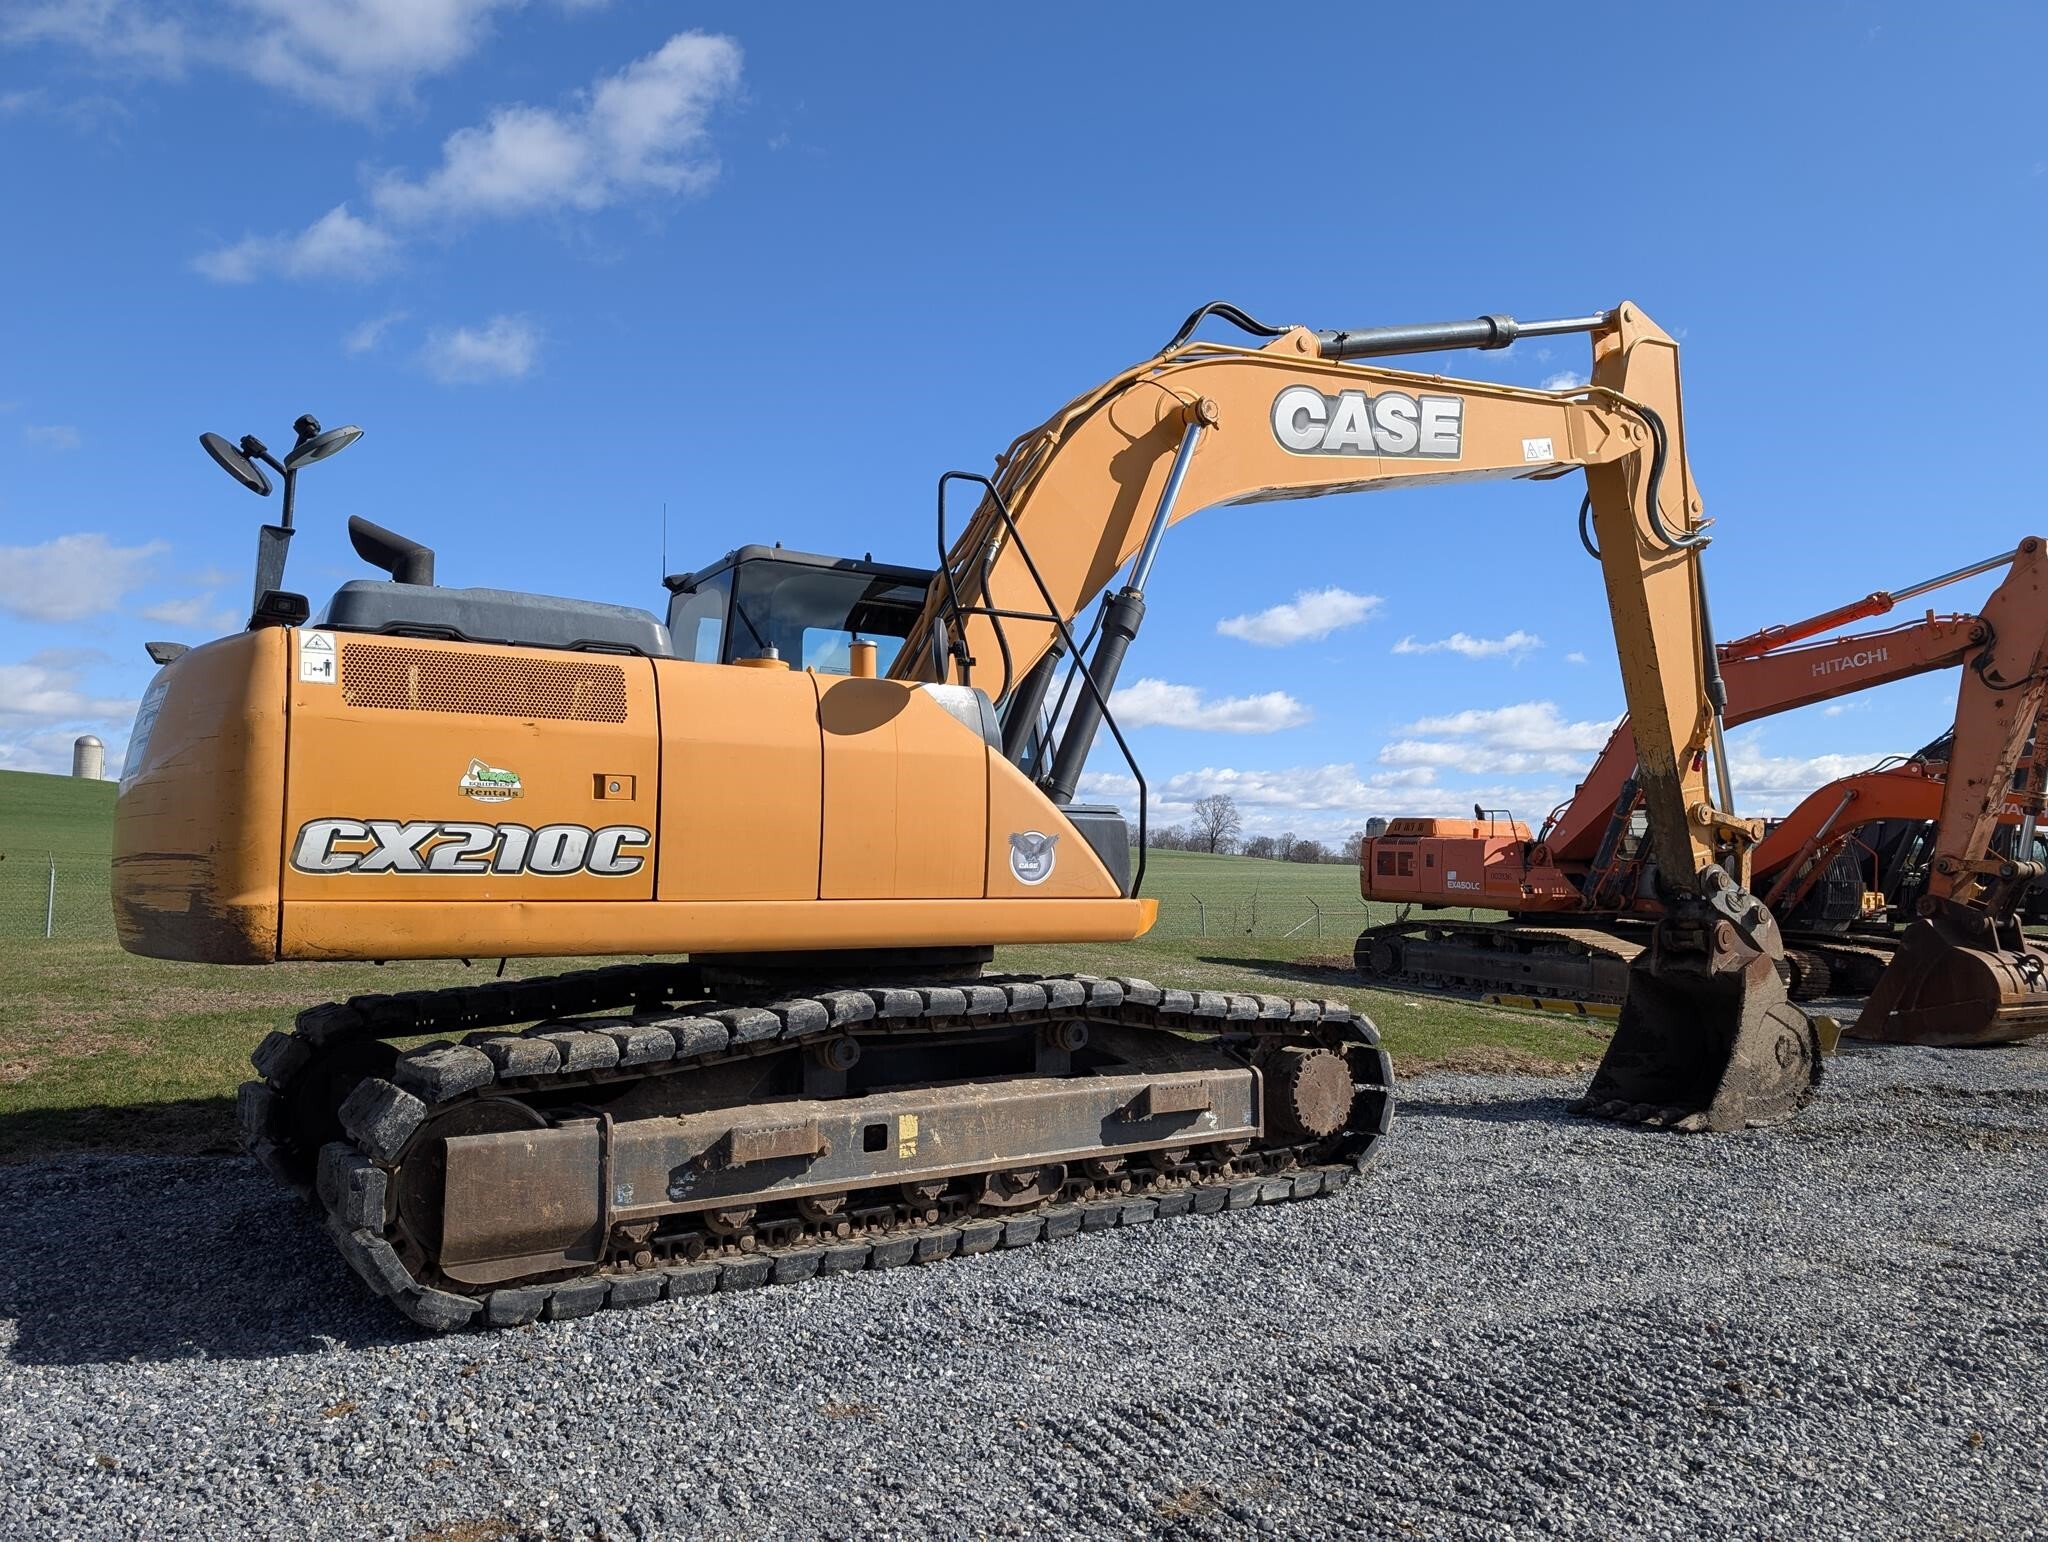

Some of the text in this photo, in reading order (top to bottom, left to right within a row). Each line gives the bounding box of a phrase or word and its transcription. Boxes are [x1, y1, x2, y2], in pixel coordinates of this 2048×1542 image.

[1274, 389, 1461, 454] CASE
[1811, 647, 1888, 677] HITACHI
[465, 788, 518, 796] Rentals
[292, 819, 652, 875] CX210C
